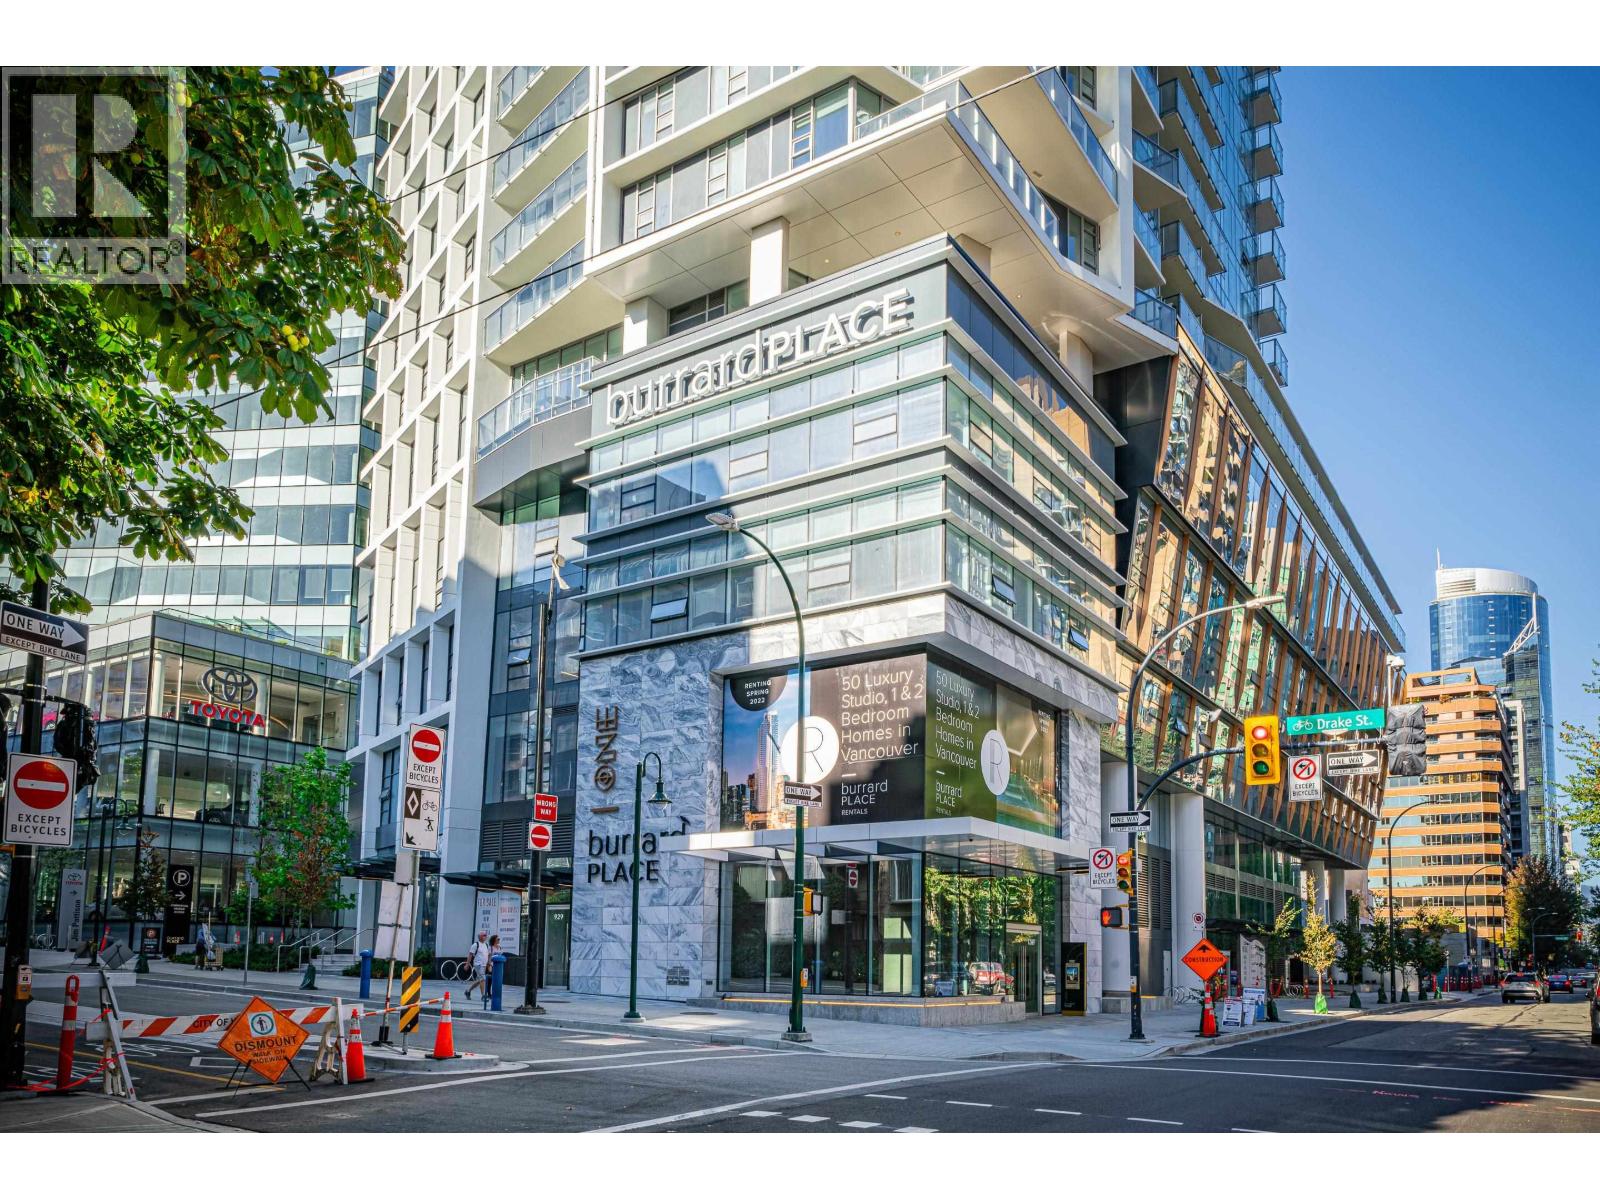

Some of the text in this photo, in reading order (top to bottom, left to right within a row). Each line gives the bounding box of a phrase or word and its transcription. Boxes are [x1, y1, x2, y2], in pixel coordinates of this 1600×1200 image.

[7, 614, 65, 639] ONE WAY
[5, 636, 81, 661] EXCEPT BIKE LANE
[745, 680, 772, 689] RENTING
[842, 669, 914, 691] 50 Luxury
[936, 669, 975, 702] 50 Luxury
[746, 688, 769, 697] SPRING
[841, 691, 888, 709] Studio,
[900, 685, 912, 701] &
[914, 683, 924, 699] 2
[936, 688, 962, 713] Studio,
[968, 702, 974, 716] &
[974, 705, 980, 719] 2
[190, 700, 266, 728] TOYOTA
[841, 706, 909, 726] Bedroom
[936, 706, 973, 734] Bedroom
[1317, 714, 1373, 730] Drake St.
[841, 723, 911, 744] Homes in
[936, 725, 974, 751] Homes in
[841, 742, 919, 761] Vancouver
[935, 741, 977, 769] Vancouver
[1330, 756, 1364, 765] ONE WAY
[413, 763, 436, 775] EXCEPT
[409, 772, 439, 785] BICYCLES
[1294, 782, 1316, 790] EXCEPT
[786, 786, 812, 796] ONE WAY
[841, 779, 888, 795] burrard
[936, 780, 962, 798] burrard
[1292, 789, 1319, 797] BICYCLES
[536, 799, 558, 808] WRONG
[841, 794, 876, 806] PLACE
[936, 793, 956, 807] PLACE
[18, 814, 61, 825] EXCEPT
[841, 808, 868, 816] RENTALS
[11, 824, 67, 836] BICYCLES
[192, 1019, 213, 1028] CITY
[216, 1018, 229, 1027] OF
[234, 1035, 297, 1053] DISMOUNT
